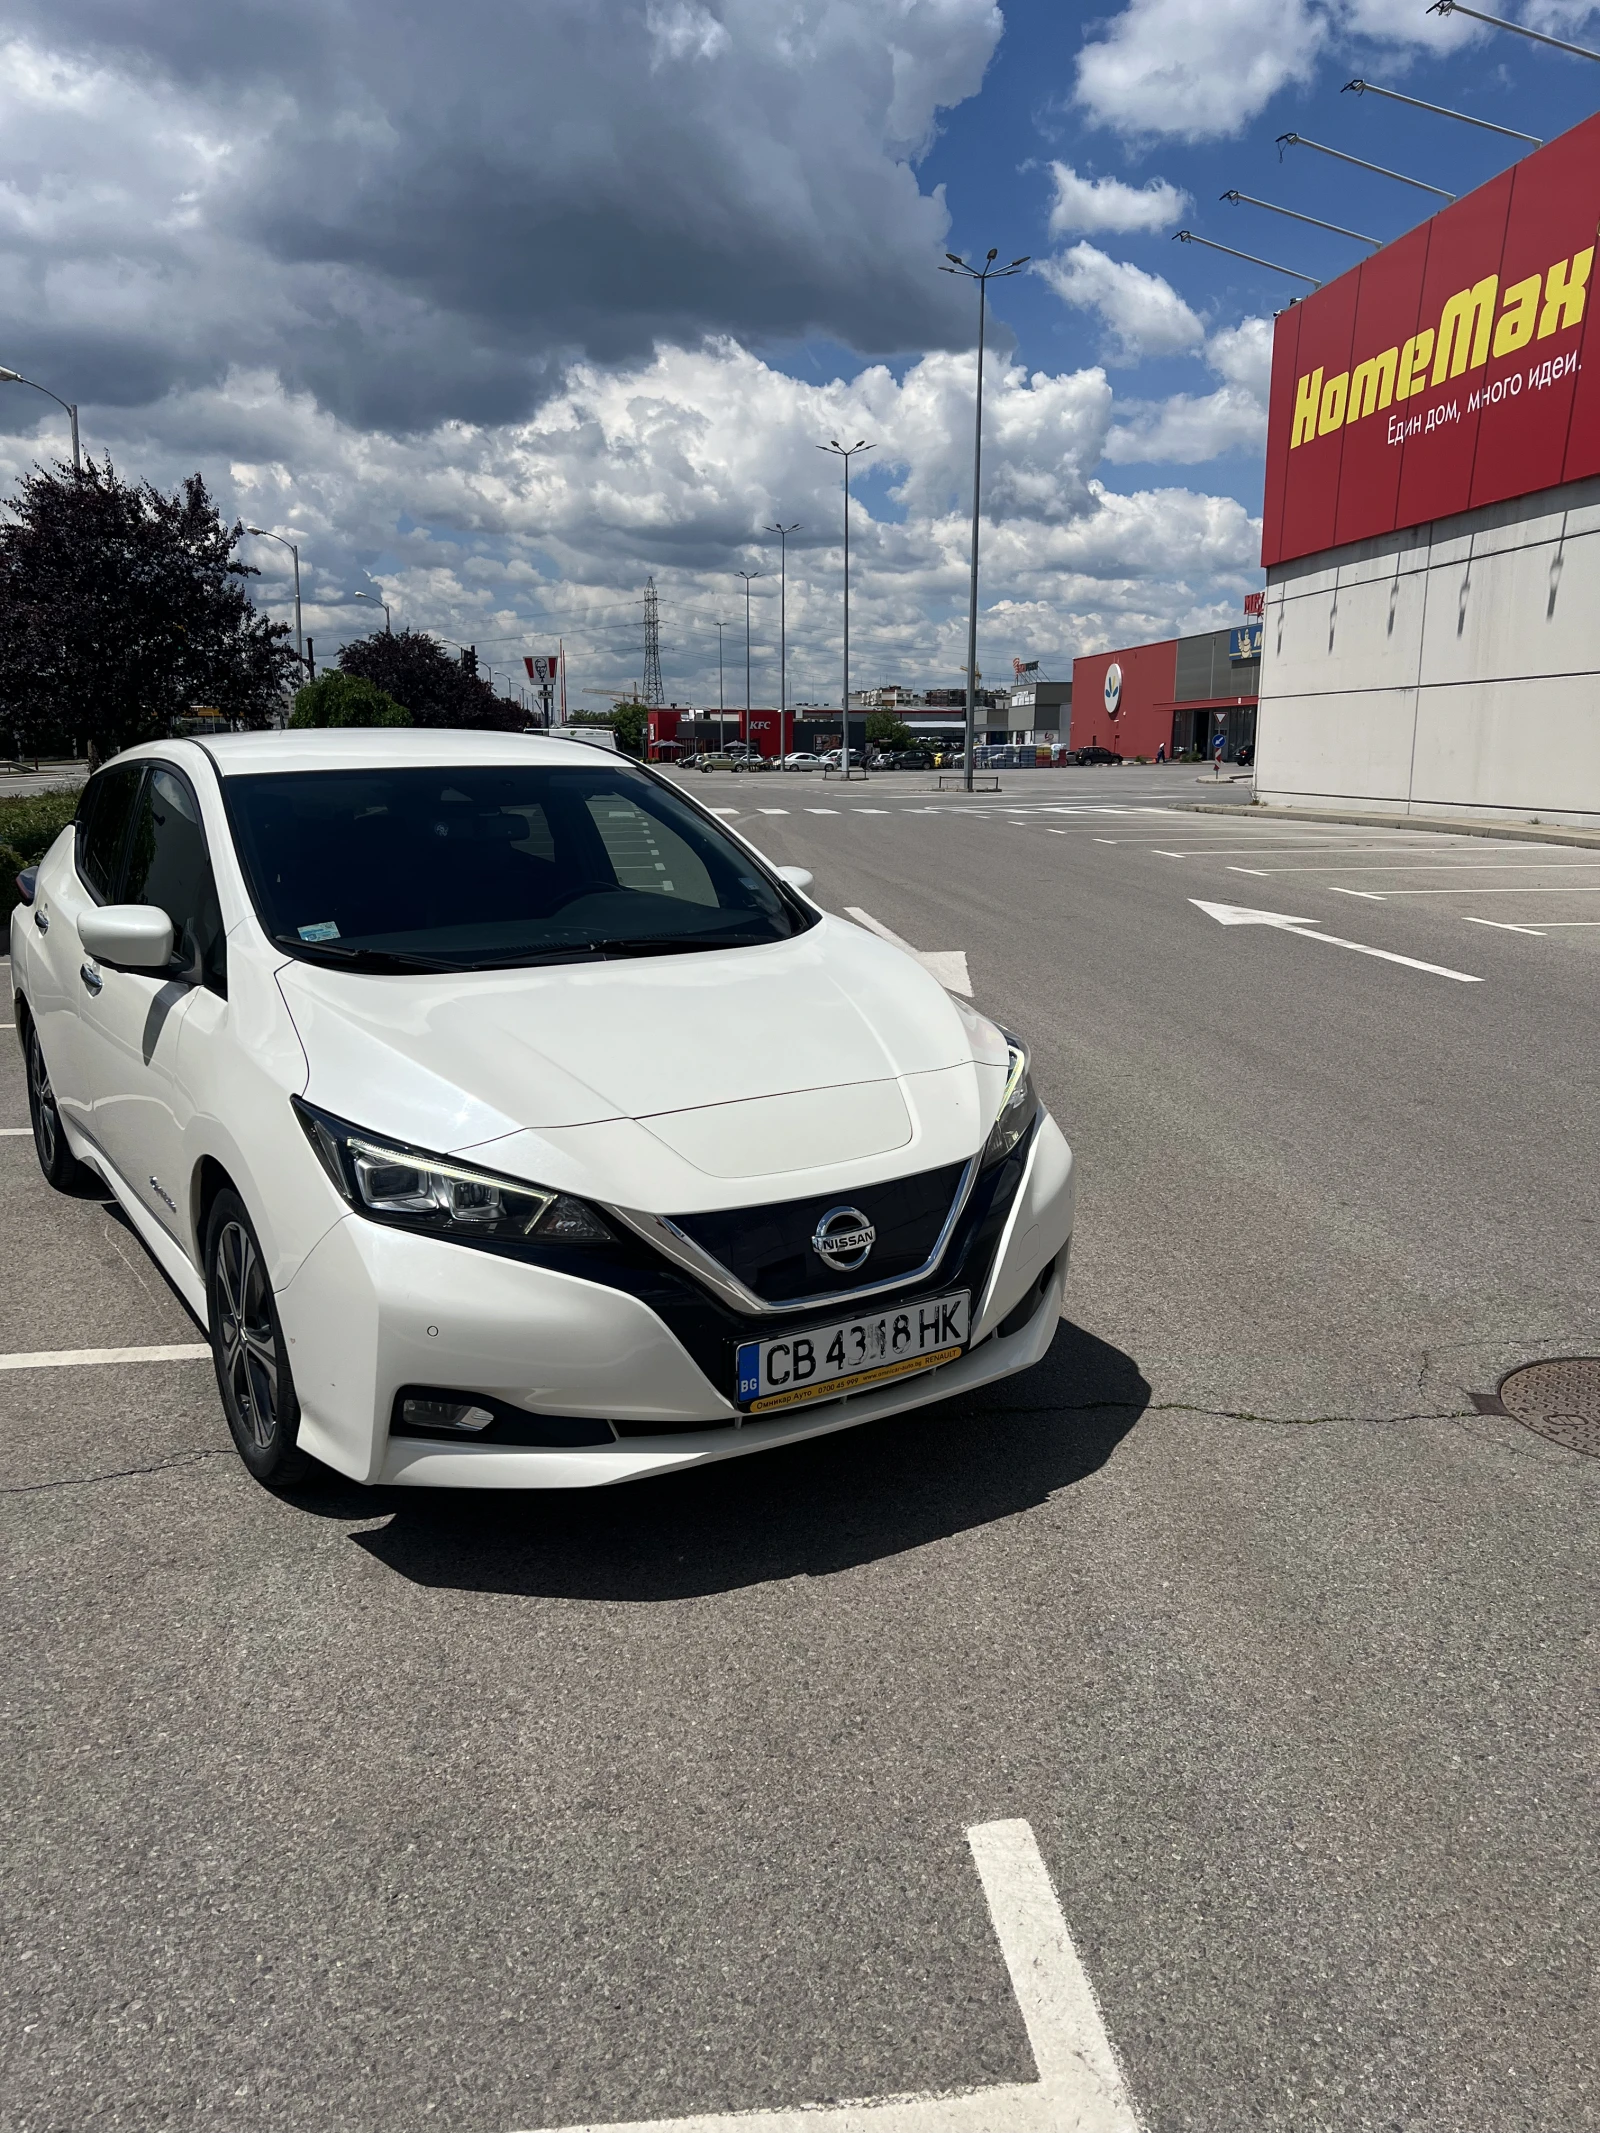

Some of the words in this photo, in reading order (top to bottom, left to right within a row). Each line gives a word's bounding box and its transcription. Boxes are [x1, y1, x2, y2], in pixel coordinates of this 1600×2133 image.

[1290, 245, 1594, 449] HomeMax
[1387, 415, 1421, 446] Един
[1424, 400, 1461, 435] дом,
[1467, 373, 1522, 414] много
[1528, 350, 1582, 391] идеи.
[750, 721, 771, 729] KFC
[823, 1230, 873, 1250] NISSAN
[766, 1339, 816, 1386] CB
[919, 1300, 962, 1348] HK
[741, 1378, 758, 1393] BG
[756, 1395, 792, 1410] Омникар
[794, 1390, 813, 1402] Ауто
[818, 1384, 835, 1394] 0700
[846, 1377, 859, 1386] 999
[863, 1361, 922, 1380] www.omnicar-auto.bg
[925, 1350, 957, 1364] RENAULT
